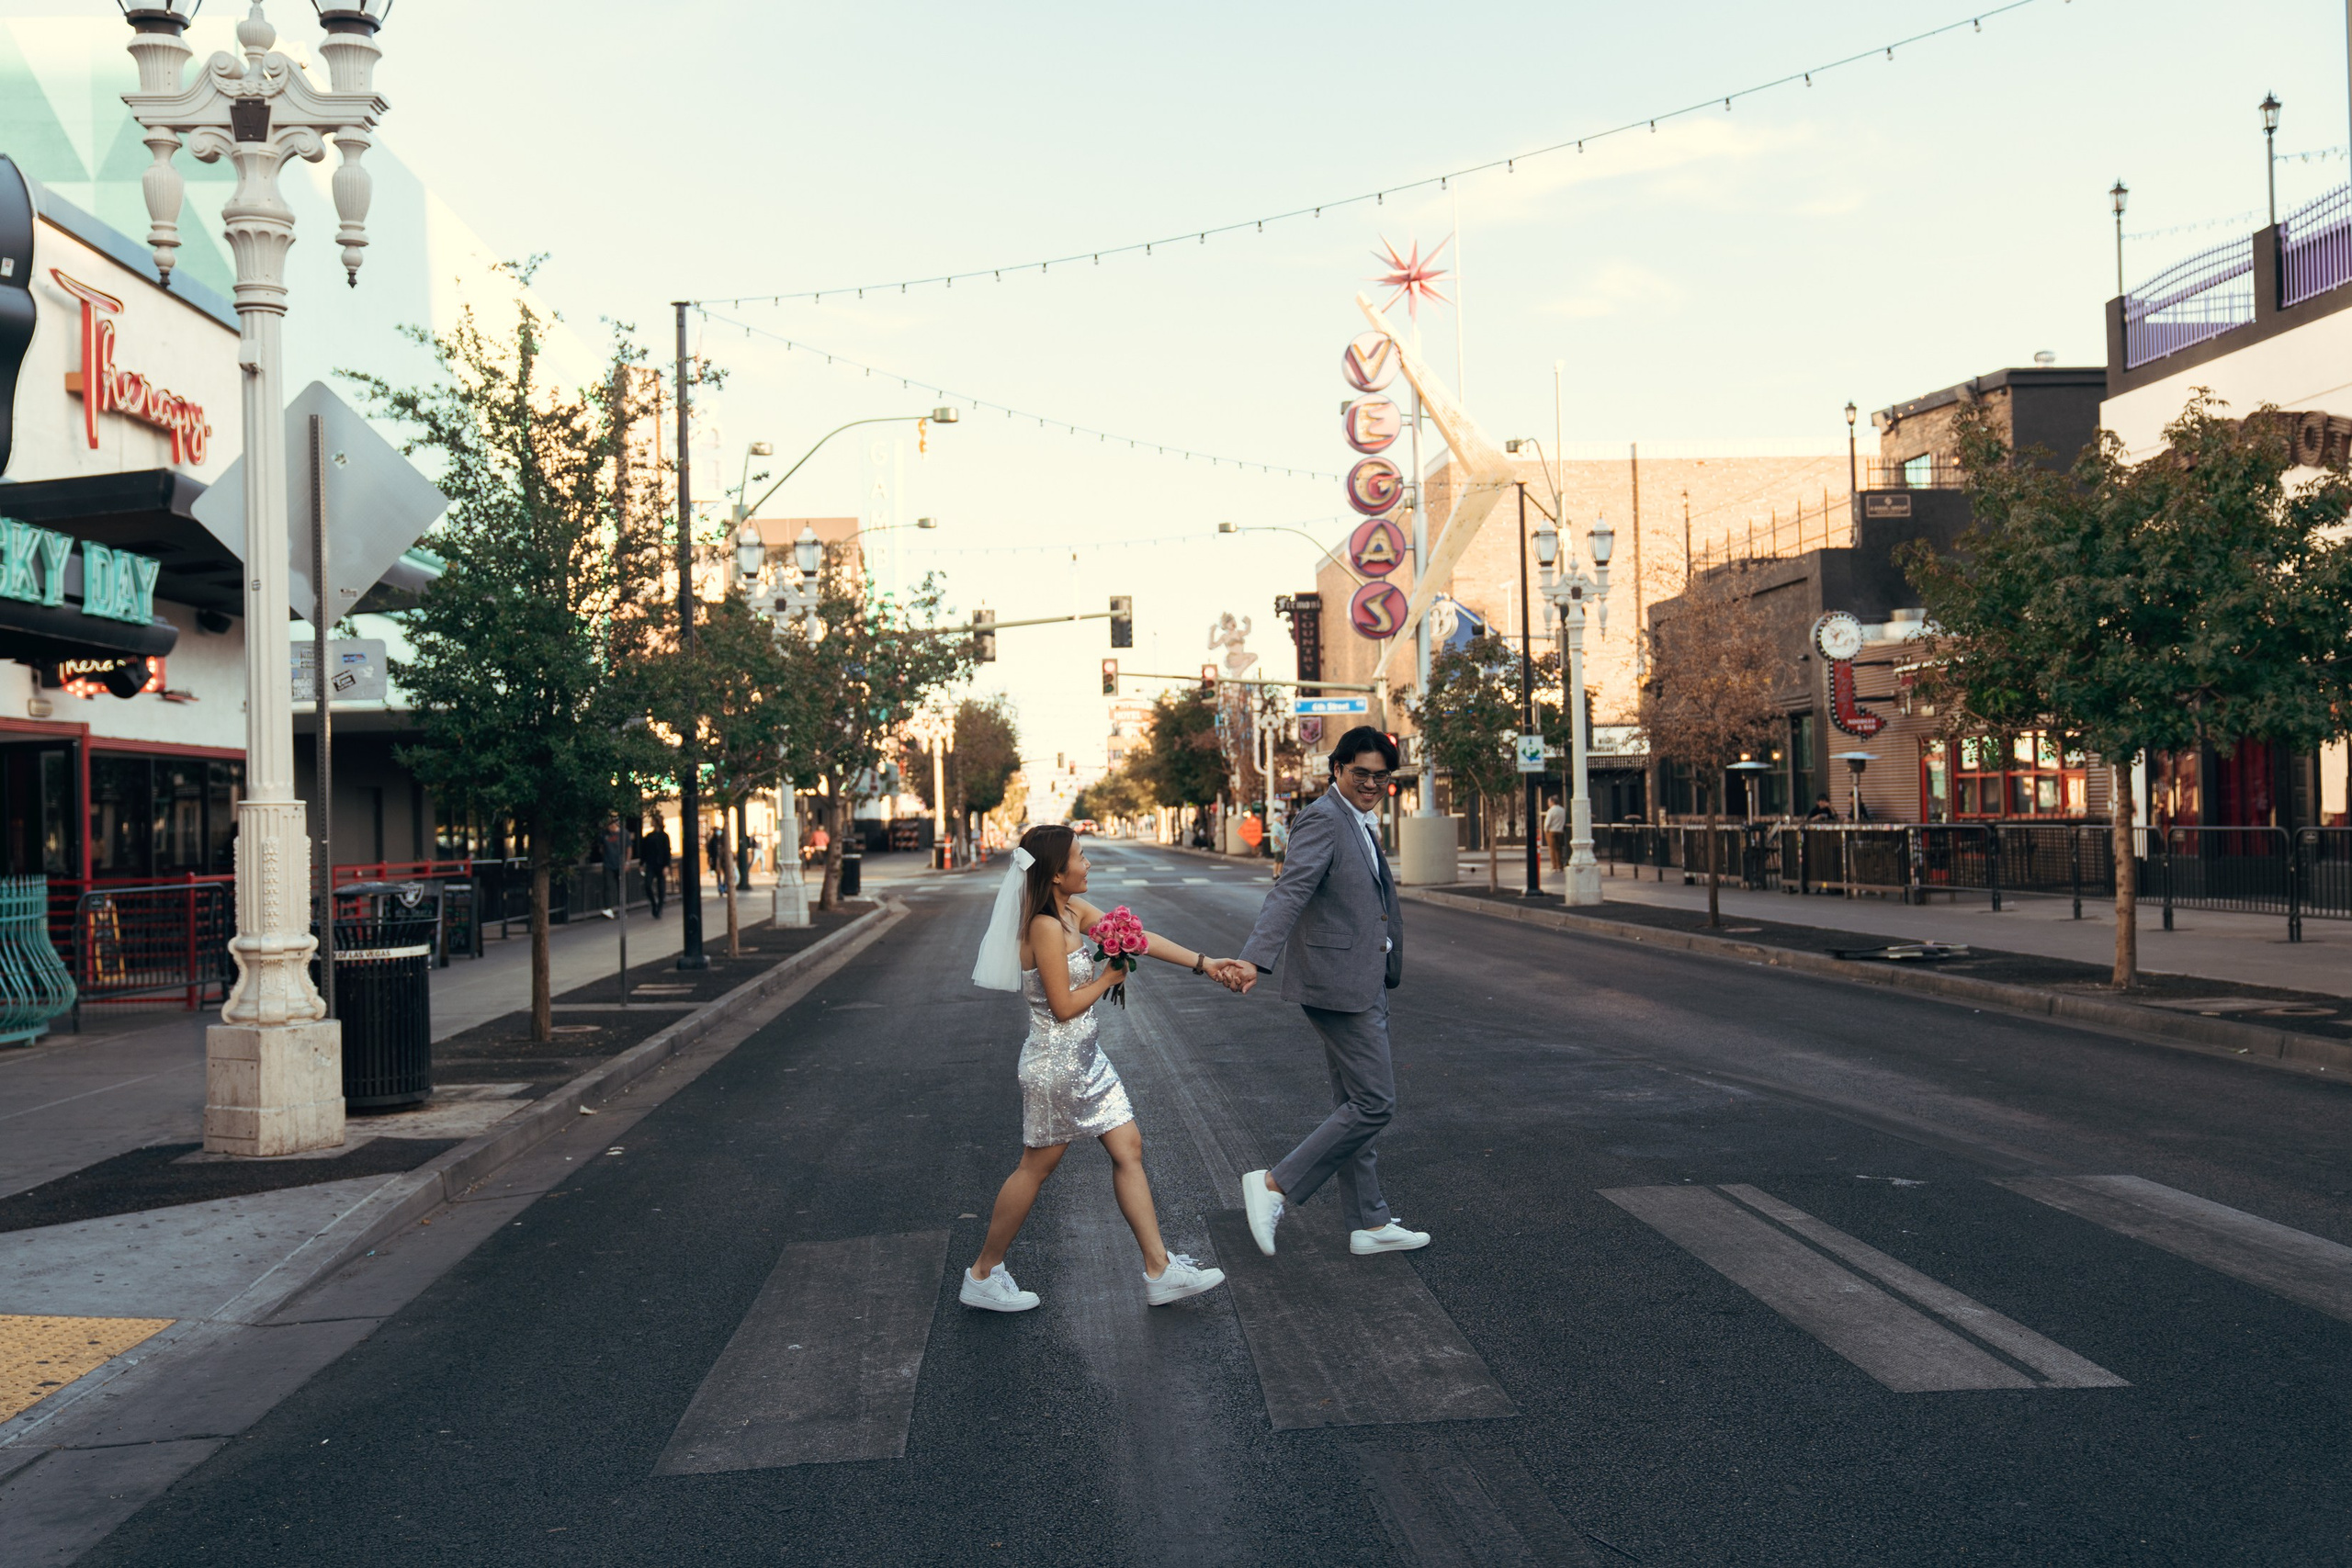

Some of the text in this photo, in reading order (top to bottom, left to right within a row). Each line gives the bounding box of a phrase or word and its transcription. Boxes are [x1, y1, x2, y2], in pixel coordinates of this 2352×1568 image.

[50, 268, 207, 465] Therapy
[1347, 337, 1399, 632] VEGAS
[81, 539, 161, 626] DAY
[1275, 596, 1321, 612] Fremont
[59, 659, 127, 680] Thera
[1301, 612, 1315, 671] COUNTRY
[1312, 703, 1326, 712] 6th
[1327, 702, 1350, 711] Street
